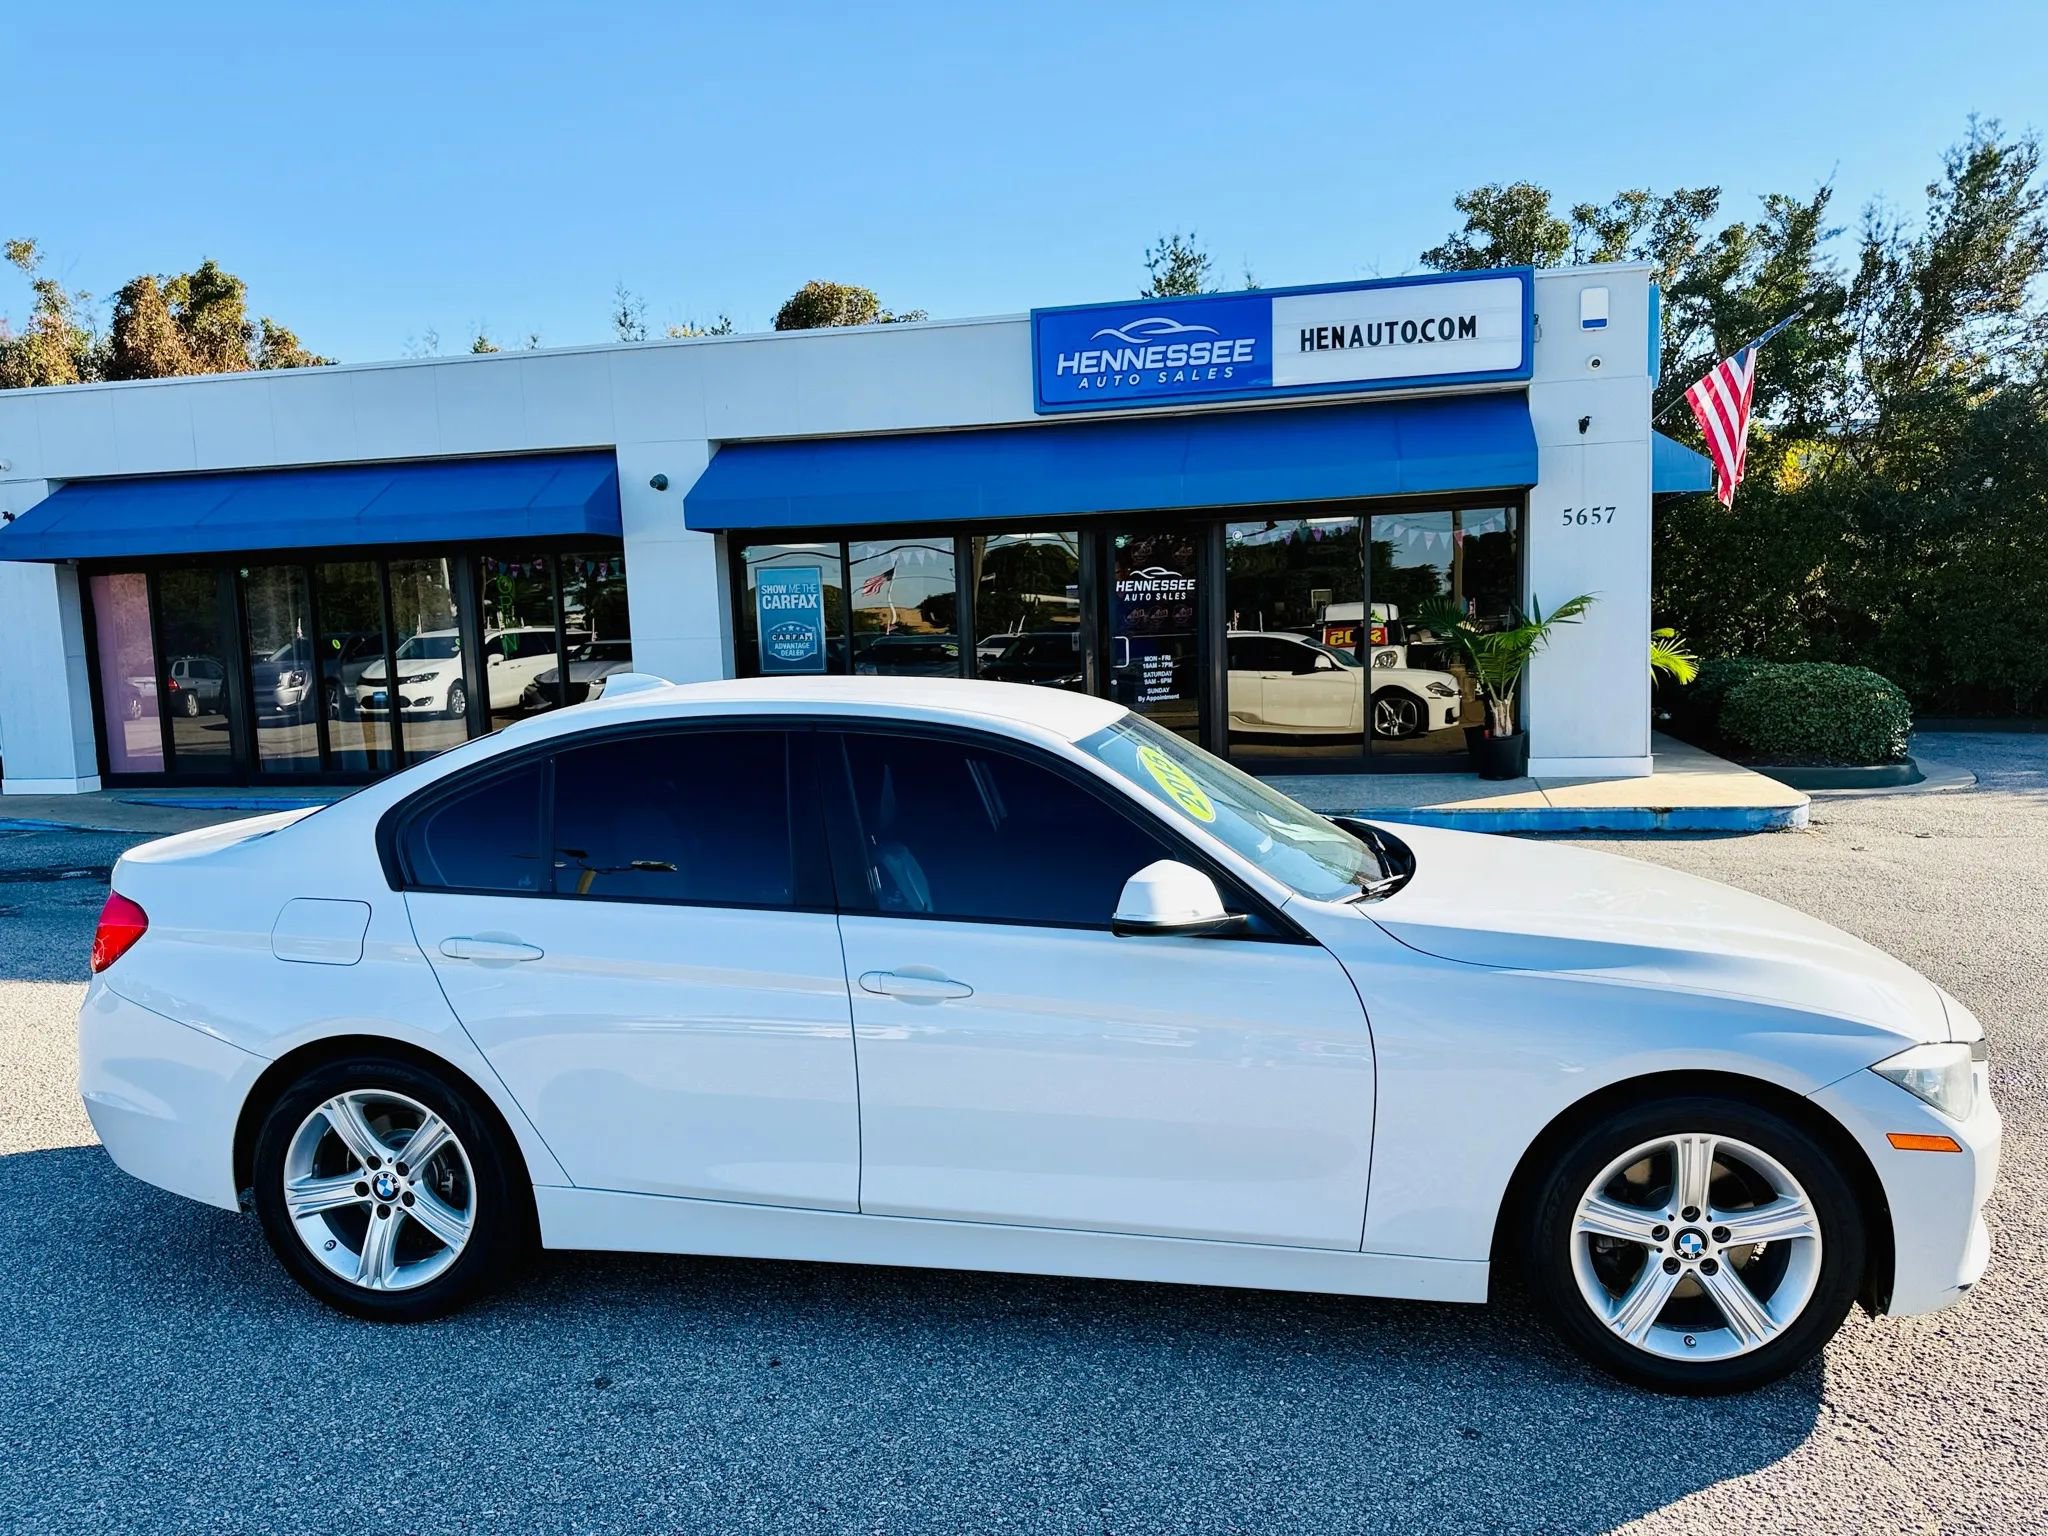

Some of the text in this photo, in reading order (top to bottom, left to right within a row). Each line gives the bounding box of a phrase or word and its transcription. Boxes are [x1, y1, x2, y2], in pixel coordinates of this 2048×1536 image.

[1300, 315, 1477, 352] HENAUTO.COM
[1056, 338, 1256, 376] HENNESSEE
[1078, 366, 1234, 389] AUTO SALES
[1562, 506, 1617, 526] 5657
[761, 584, 817, 594] SHOW ME THE
[1116, 579, 1196, 592] HENNESSEE
[762, 594, 818, 610] CARFAX
[1124, 592, 1186, 601] AUTO SALES
[772, 633, 813, 641] CARFAX
[774, 642, 810, 650] ADVANTAGE
